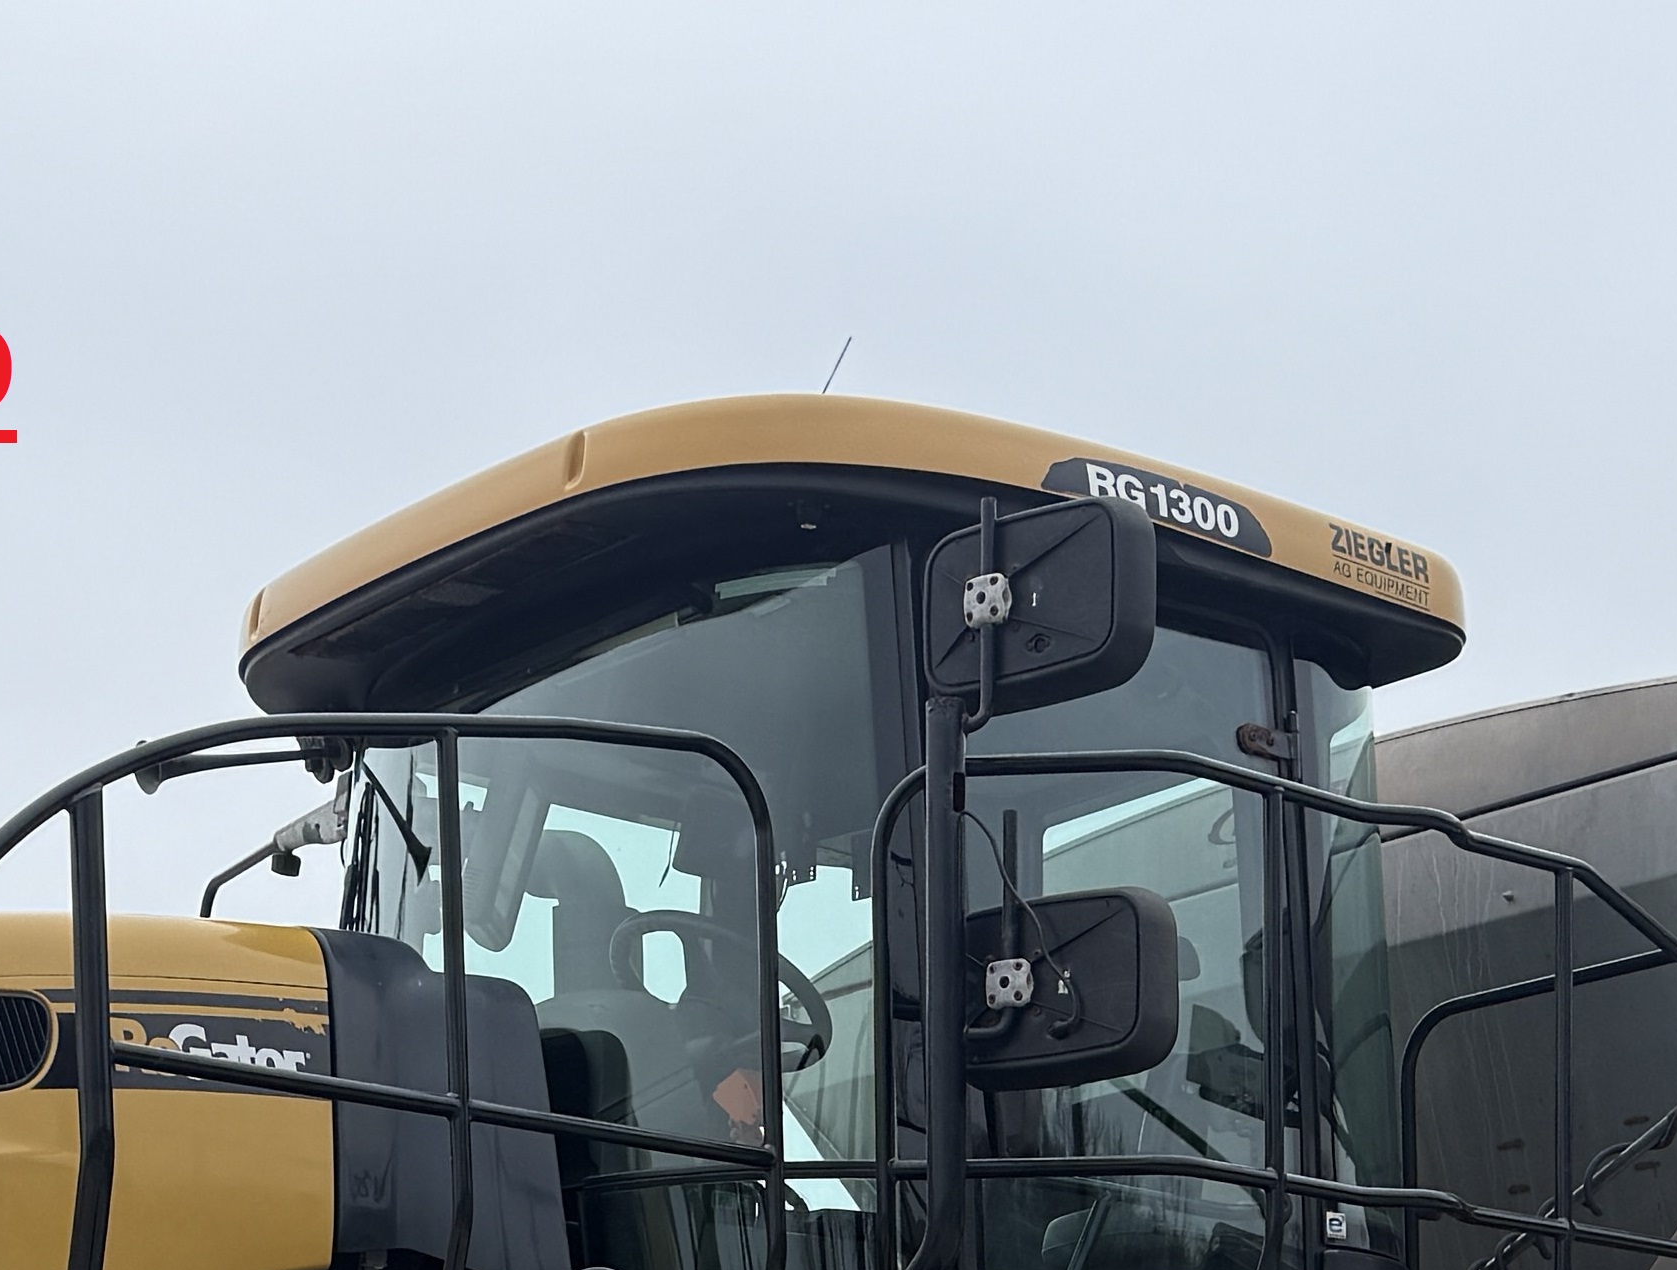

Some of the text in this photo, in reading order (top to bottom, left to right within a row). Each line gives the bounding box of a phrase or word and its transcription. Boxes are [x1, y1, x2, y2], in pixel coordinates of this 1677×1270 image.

[1329, 523, 1429, 583] ZIEGLER
[1334, 561, 1430, 606] AG EQUIPMENT
